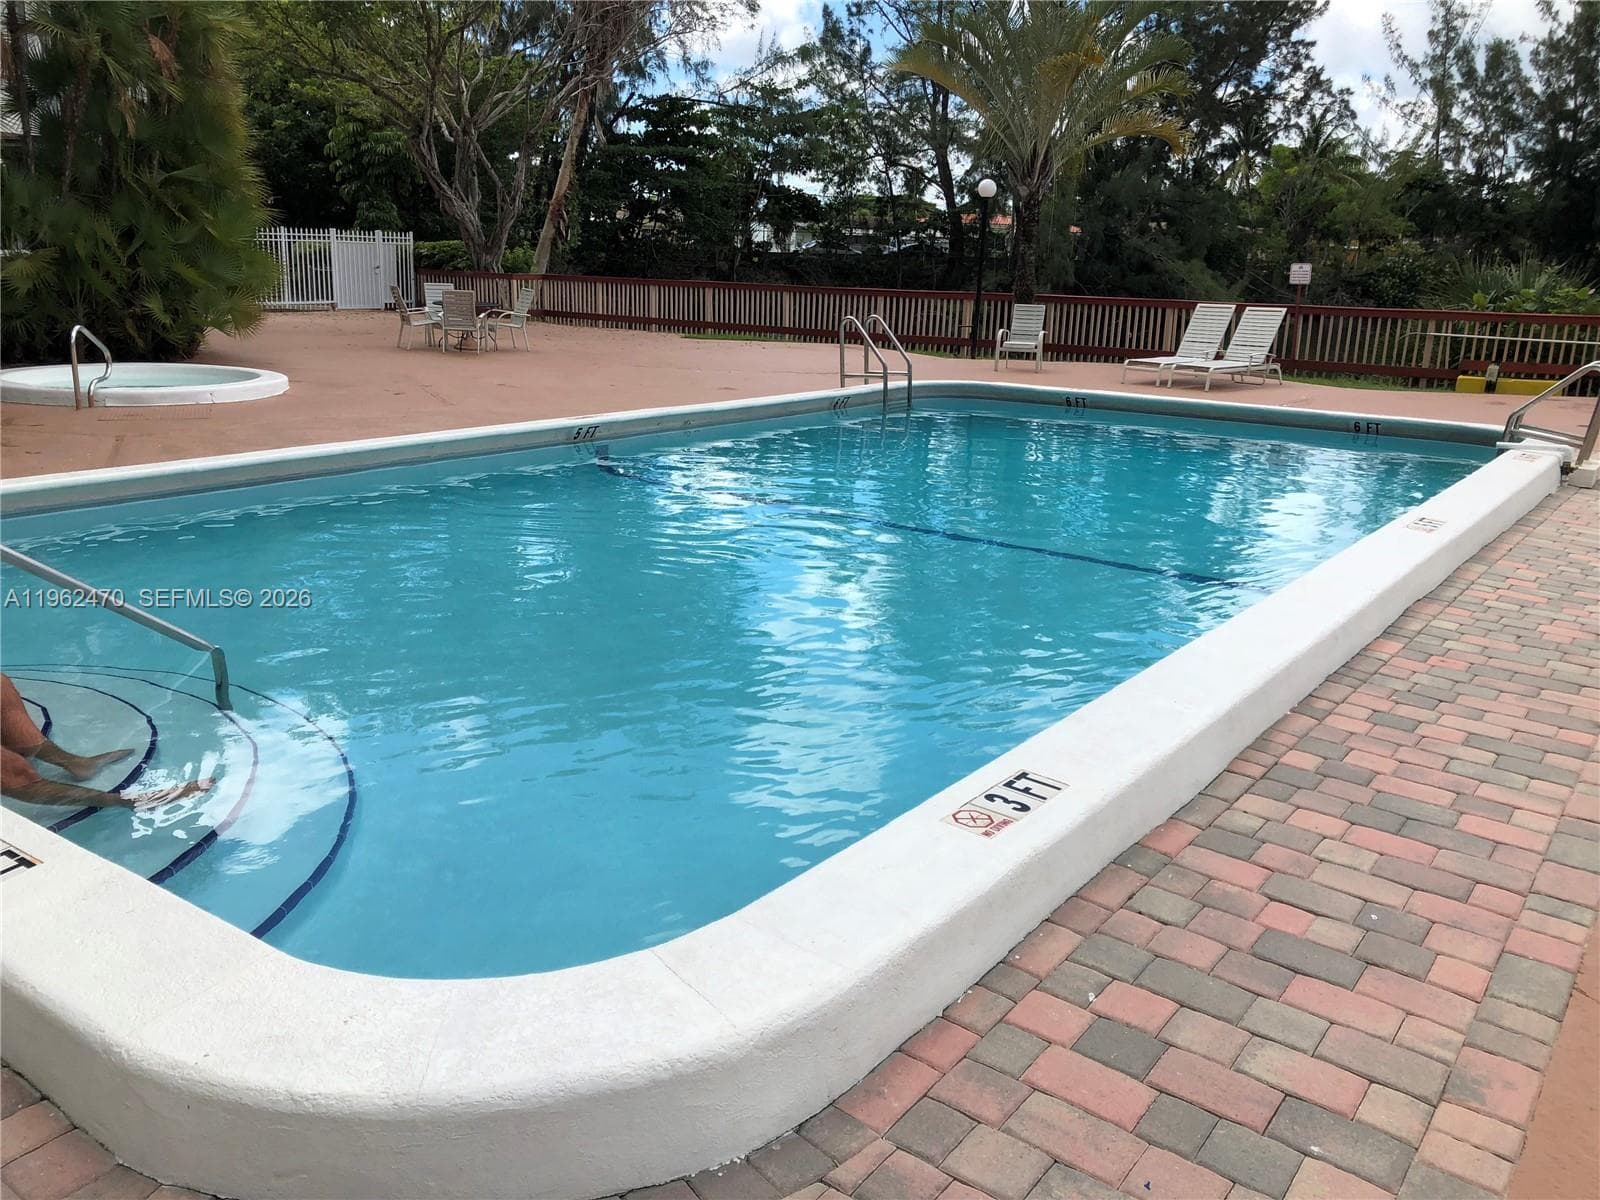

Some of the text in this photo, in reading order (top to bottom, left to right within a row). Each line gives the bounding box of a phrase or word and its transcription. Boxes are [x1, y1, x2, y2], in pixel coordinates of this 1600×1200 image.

[1066, 396, 1087, 408] 6 FT
[573, 425, 600, 440] 5 FT
[1353, 421, 1382, 434] 6 FT
[983, 771, 1062, 813] 3 FT
